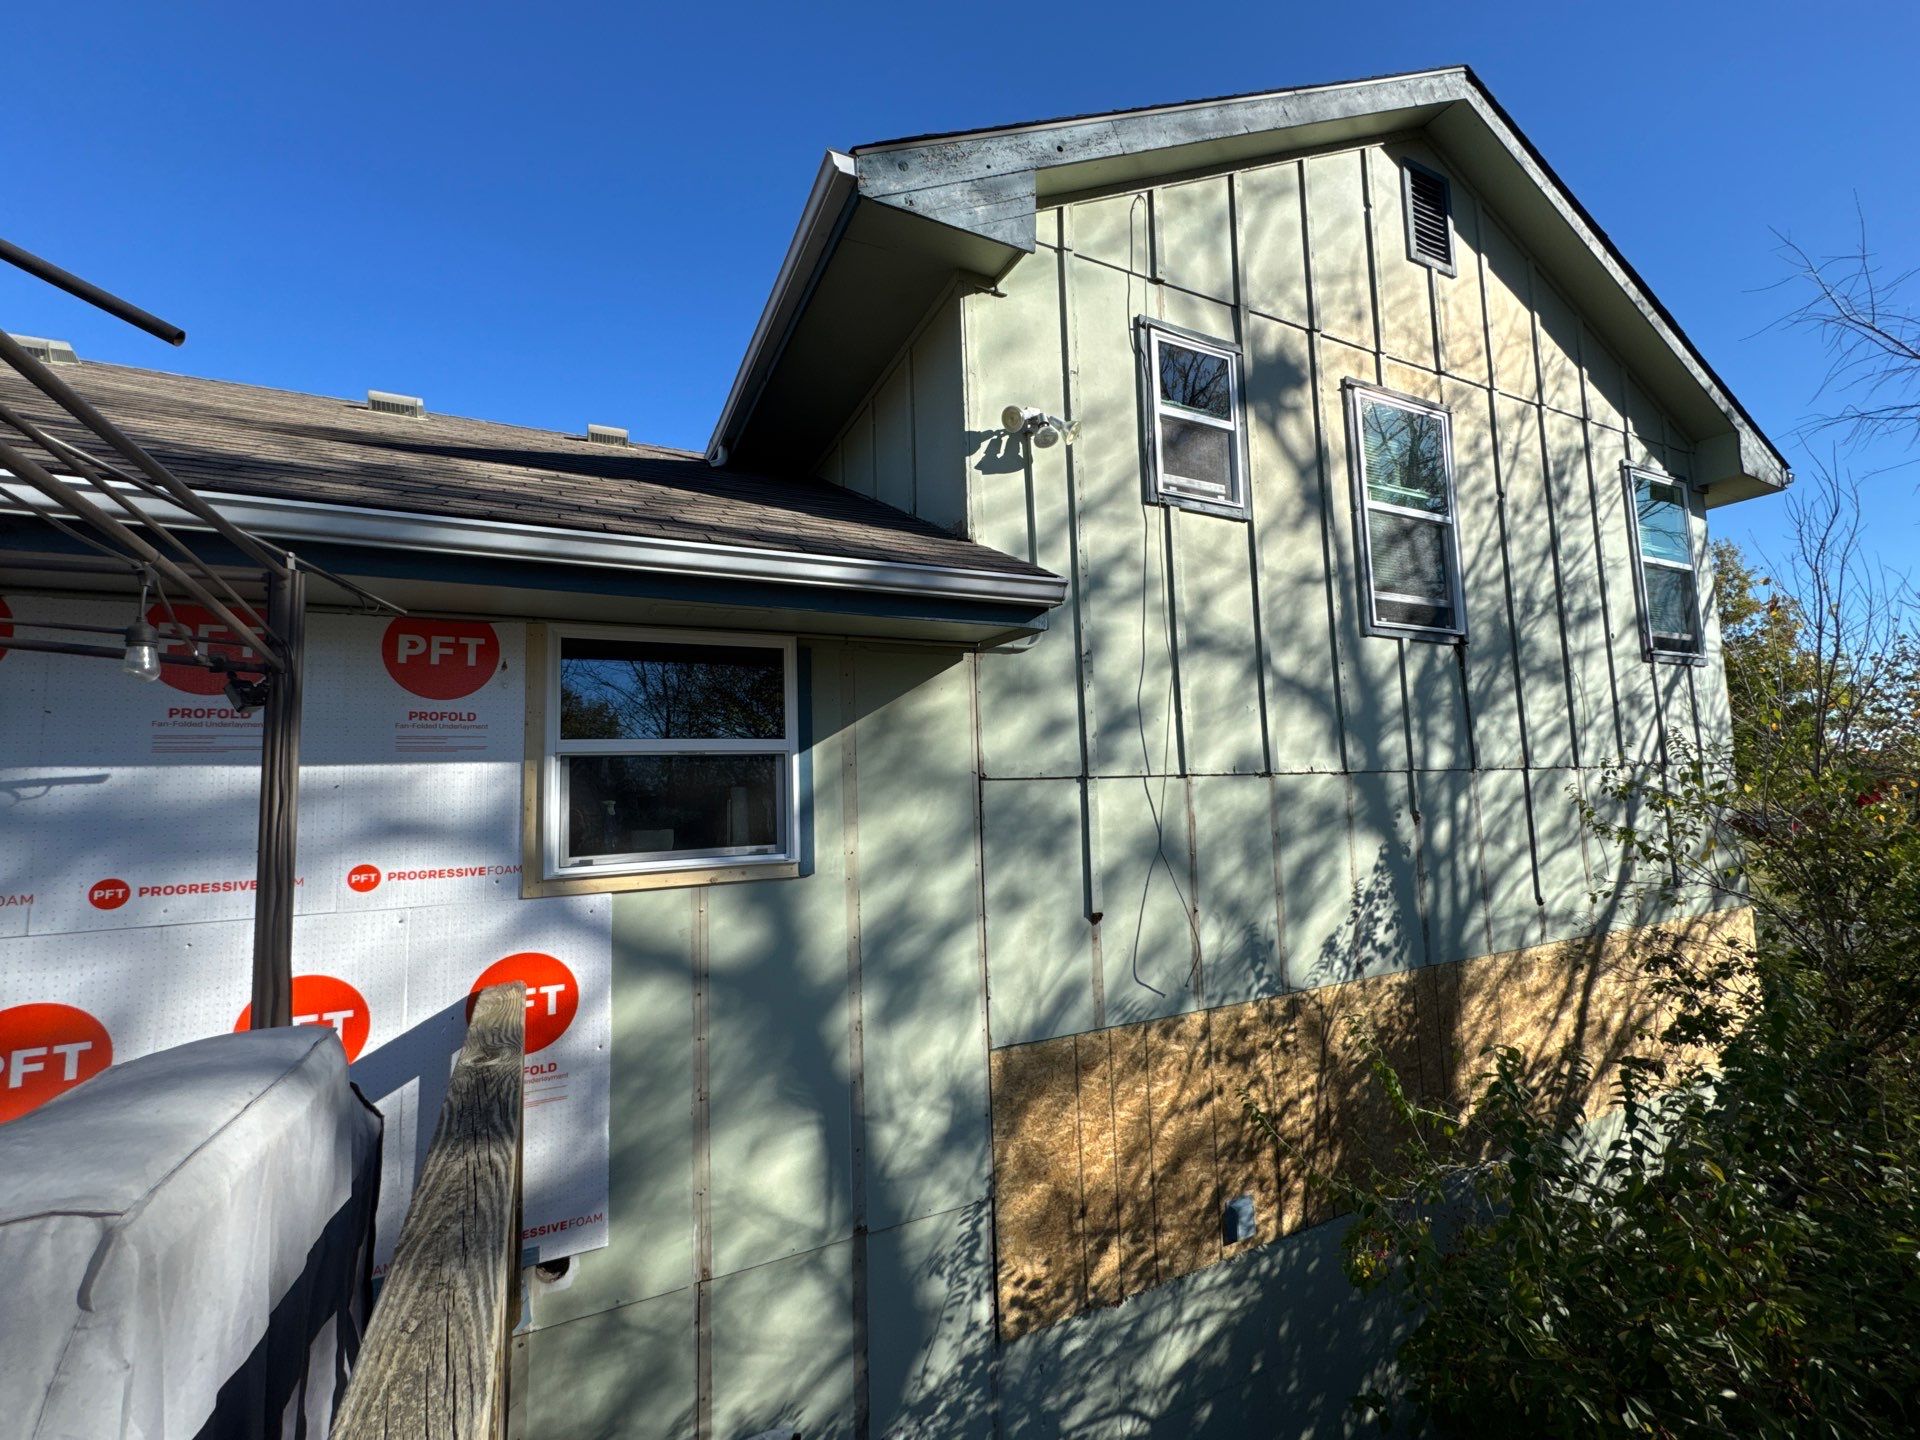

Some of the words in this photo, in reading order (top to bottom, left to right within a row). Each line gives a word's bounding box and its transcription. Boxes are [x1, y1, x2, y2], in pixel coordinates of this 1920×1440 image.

[397, 634, 485, 666] PFT
[168, 707, 252, 720] PROFOLD
[408, 711, 477, 722] PROFOLD
[152, 721, 203, 729] Fan-Folded
[205, 721, 264, 729] Underlaymen
[439, 723, 488, 731] Underlayment
[351, 873, 377, 883] PFT
[387, 864, 523, 881] PROGRESSIVEFOAM
[93, 888, 126, 900] PFT
